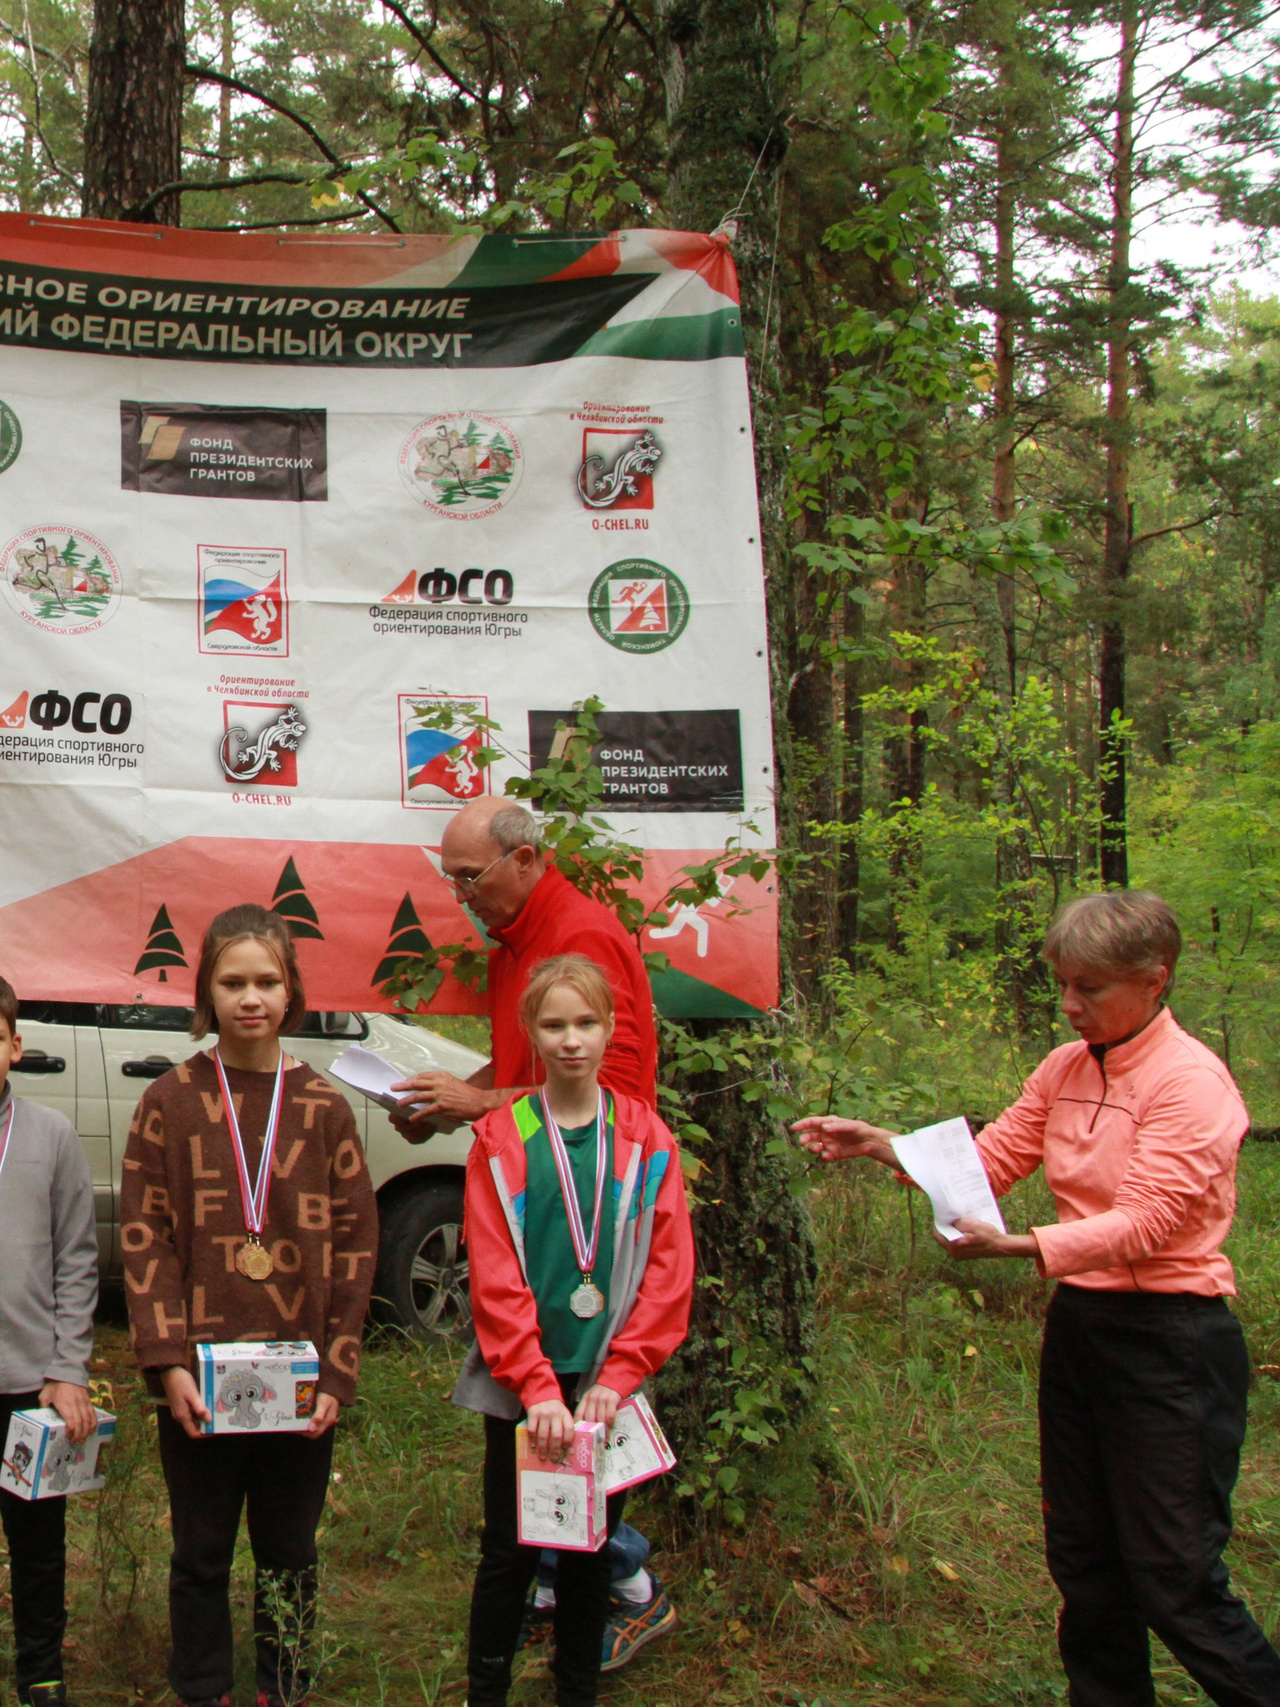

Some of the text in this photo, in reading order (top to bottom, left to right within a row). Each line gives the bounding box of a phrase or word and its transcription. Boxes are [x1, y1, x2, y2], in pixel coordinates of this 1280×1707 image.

[98, 286, 471, 320] ОРИЕНТИРОВАНИЕ
[51, 313, 343, 357] ФЕДЕРАЛЬНЫЙ
[355, 331, 472, 358] ОКРУГ
[190, 437, 233, 451] ФОНД
[190, 452, 313, 469] ПРЕЗИДЕНТСКИХ
[190, 468, 256, 482] ГРАНТОВ
[591, 519, 649, 531] O-CHEL.RU
[417, 567, 514, 605] ФСО
[369, 605, 528, 624] Федерация спортивного
[373, 622, 521, 639] ориентирования Югры
[220, 674, 296, 687] Ориентирование
[214, 684, 269, 697] Челябинской
[271, 688, 310, 698] области
[29, 689, 132, 735] ФСО
[57, 738, 145, 754] спортивного
[98, 753, 137, 770] Югры
[600, 749, 644, 762] ФОНД
[601, 765, 729, 778] ПРЕЗИДЕНТСКИХ
[601, 782, 669, 794] ГРАНТОВ
[232, 792, 292, 806] O-CHEL.RU
